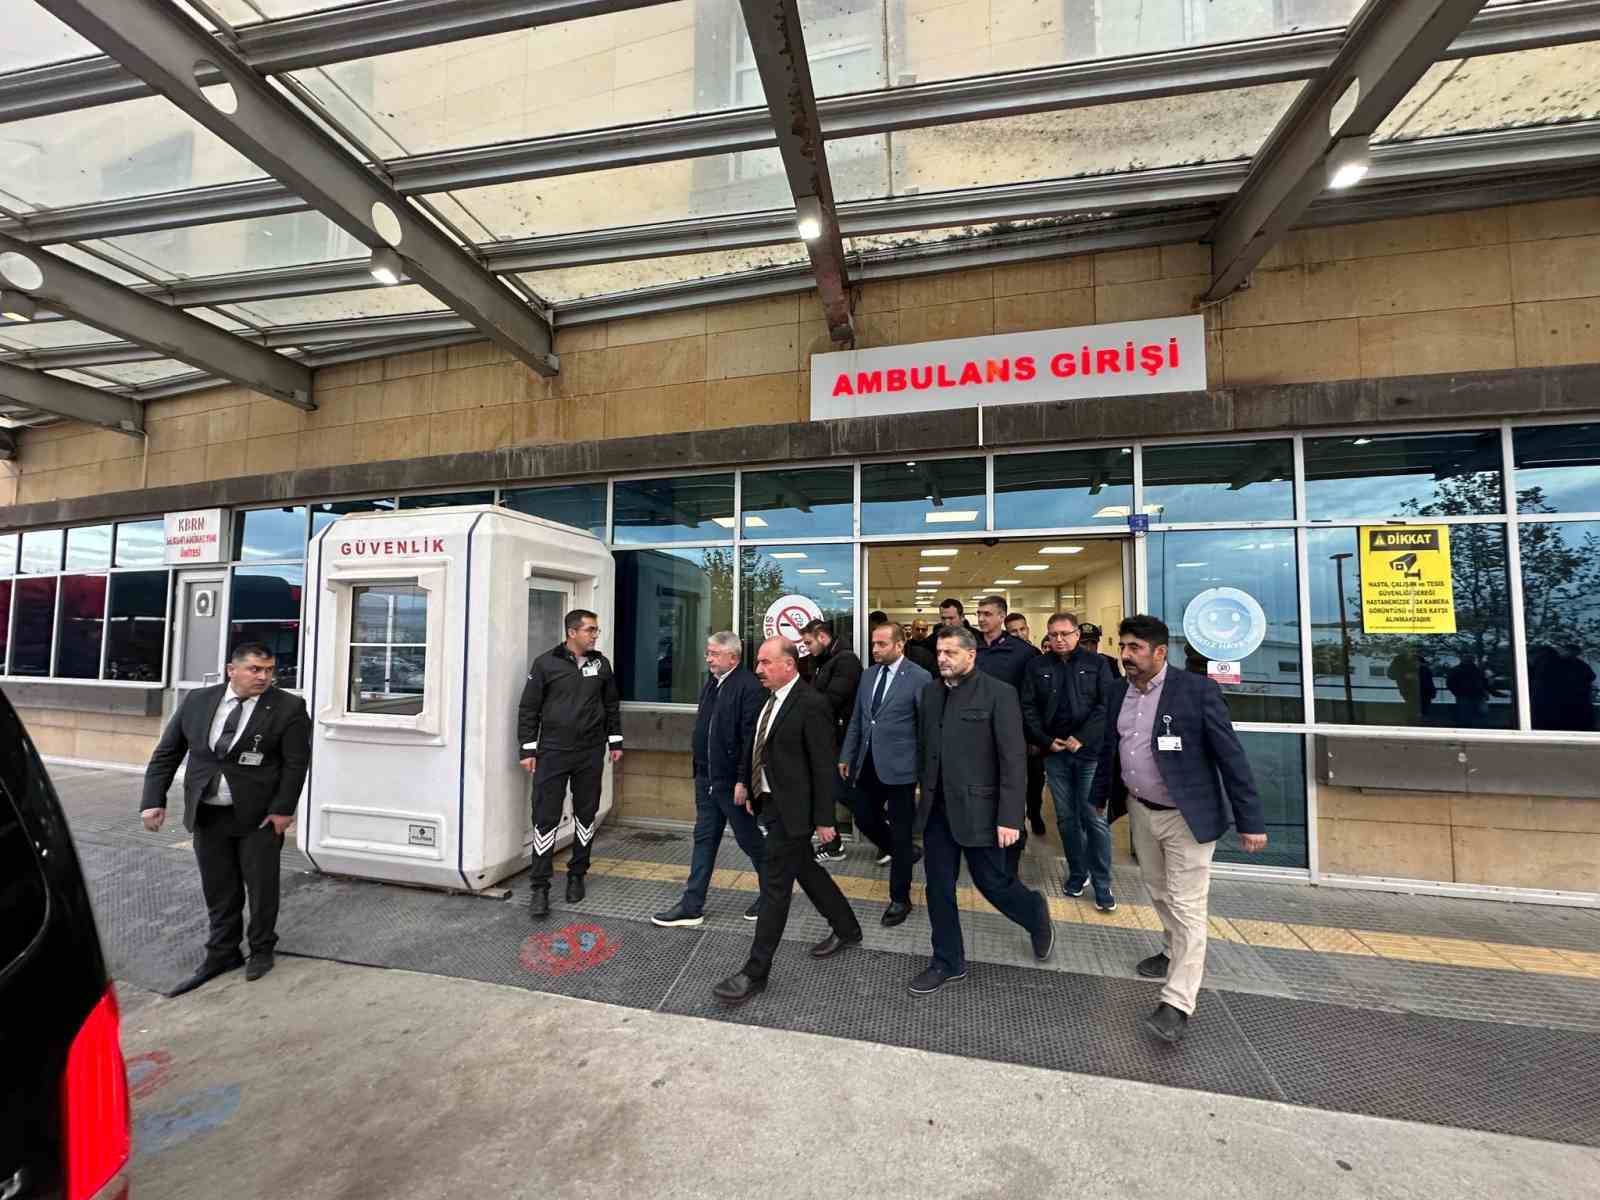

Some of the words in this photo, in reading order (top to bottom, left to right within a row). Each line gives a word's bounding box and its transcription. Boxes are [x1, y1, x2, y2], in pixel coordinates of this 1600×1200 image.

[832, 356, 1036, 397] AMBULANS
[1050, 336, 1180, 376] GİRİŞİ
[341, 536, 444, 555] GÜVENLİK
[1387, 532, 1431, 545] DİKKAT
